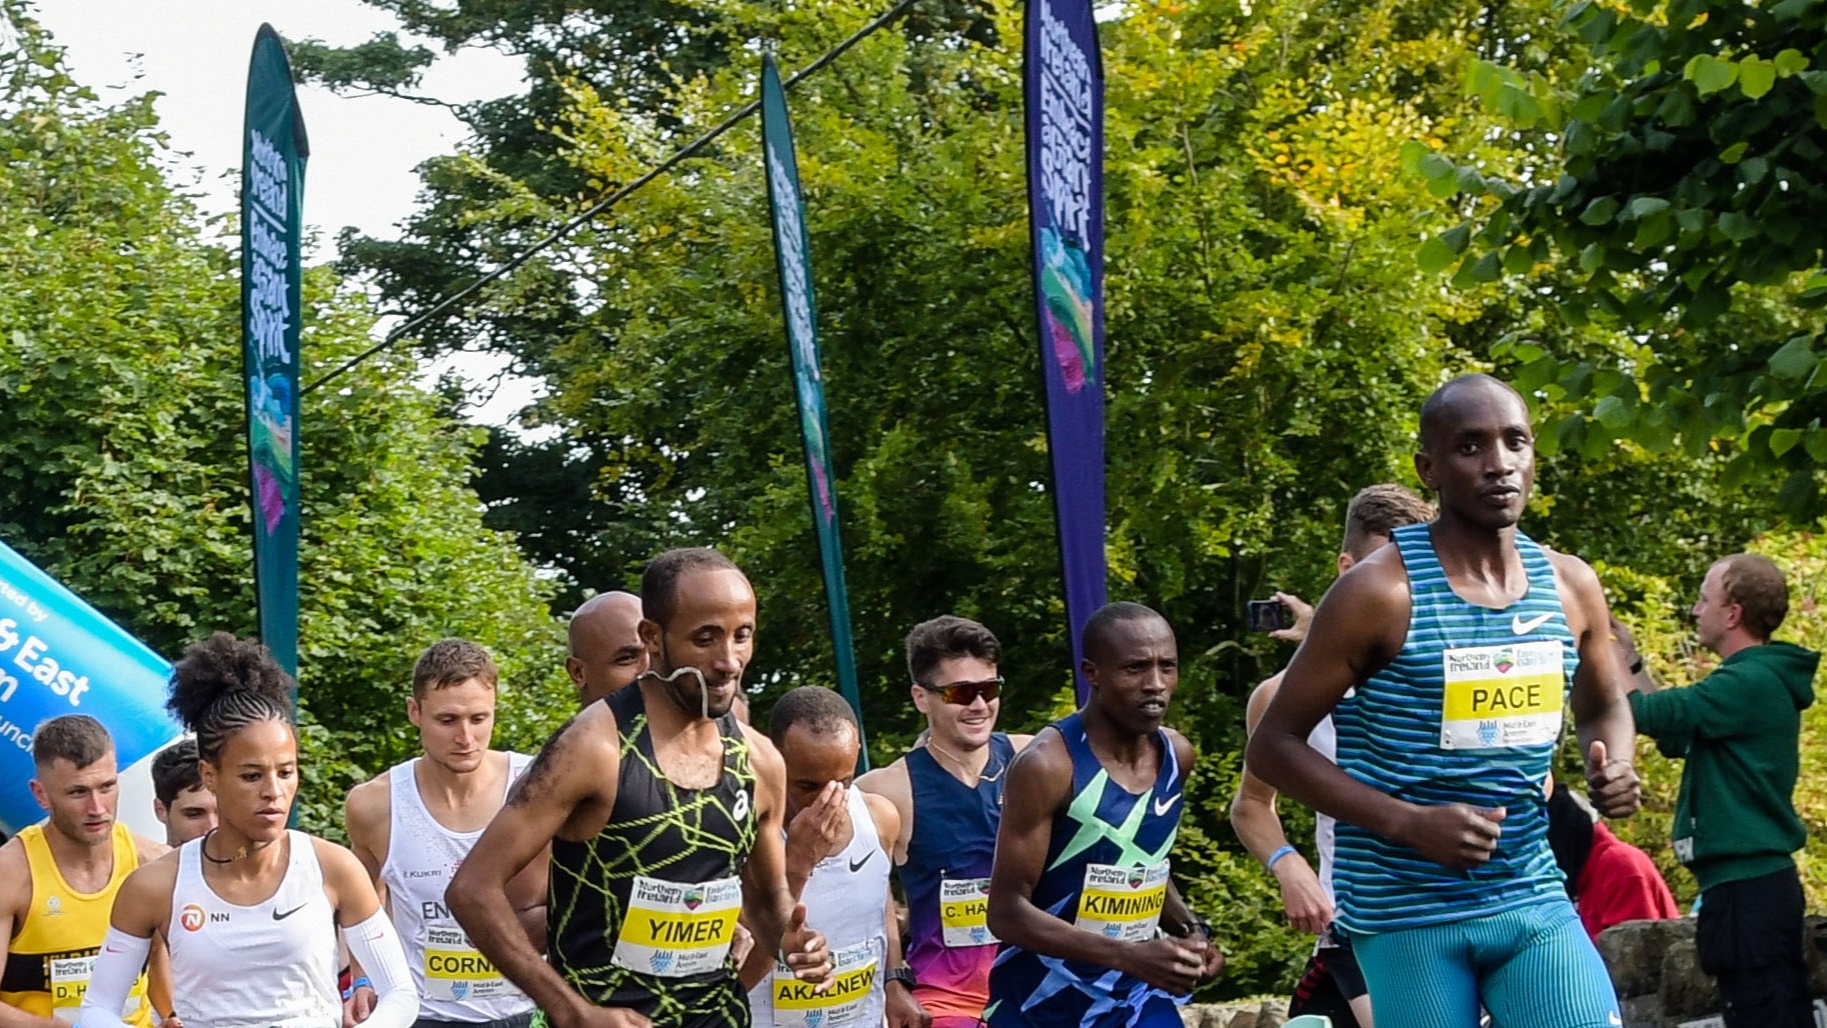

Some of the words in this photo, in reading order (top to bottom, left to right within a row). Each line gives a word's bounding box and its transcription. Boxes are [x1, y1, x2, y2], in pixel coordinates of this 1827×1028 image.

[26, 600, 48, 623] by
[13, 636, 91, 708] East
[1472, 684, 1540, 712] PACE
[945, 906, 961, 918] C.
[1084, 890, 1163, 915] KIMINING
[211, 913, 230, 922] NN
[648, 919, 724, 943] YIMER
[56, 986, 72, 998] D.
